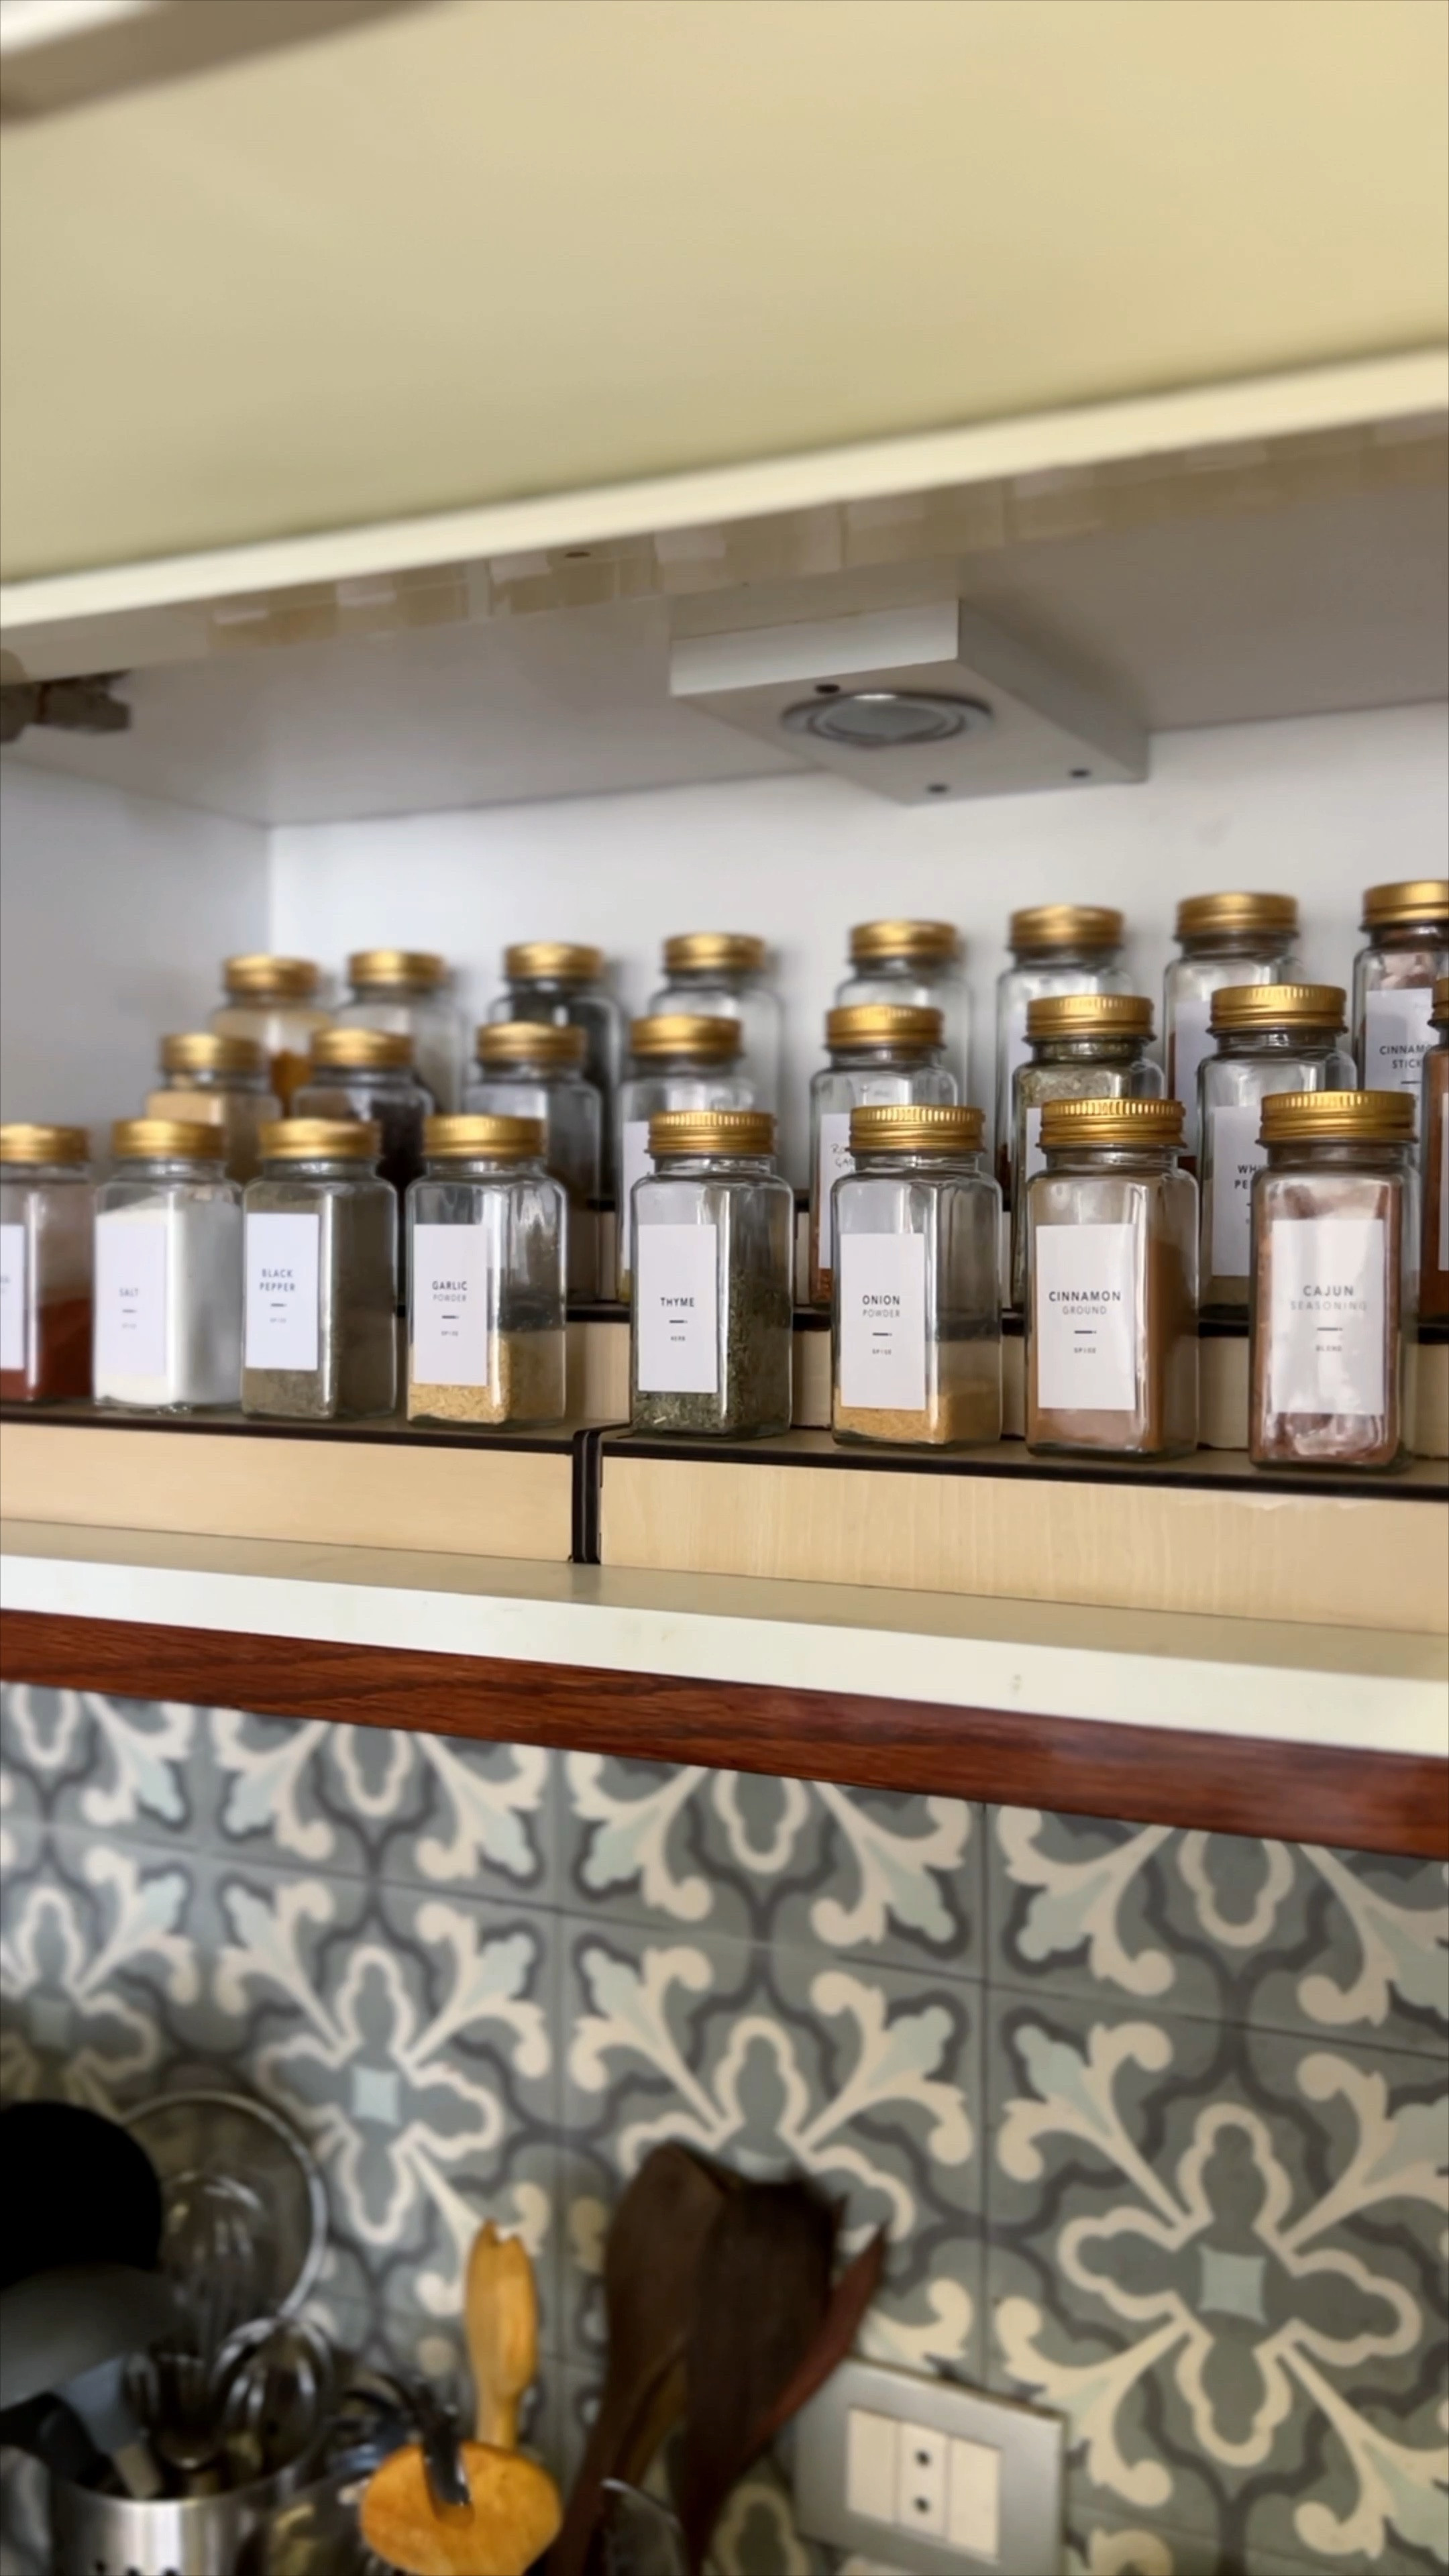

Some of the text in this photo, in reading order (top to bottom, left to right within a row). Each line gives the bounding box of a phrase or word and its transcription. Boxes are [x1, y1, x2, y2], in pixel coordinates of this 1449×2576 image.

[262, 1268, 293, 1278] BLACK
[259, 1282, 295, 1292] PEPPER
[431, 1280, 468, 1291] GARLIC
[119, 1287, 139, 1297] SALT
[1049, 1291, 1121, 1301] CINNAMON
[1303, 1285, 1354, 1297] CAJUN
[660, 1297, 694, 1307] THYME
[862, 1295, 900, 1305] ONION
[1062, 1305, 1107, 1315] GROUND
[1290, 1300, 1367, 1311] SEASONING
[863, 1309, 900, 1318] POWDER
